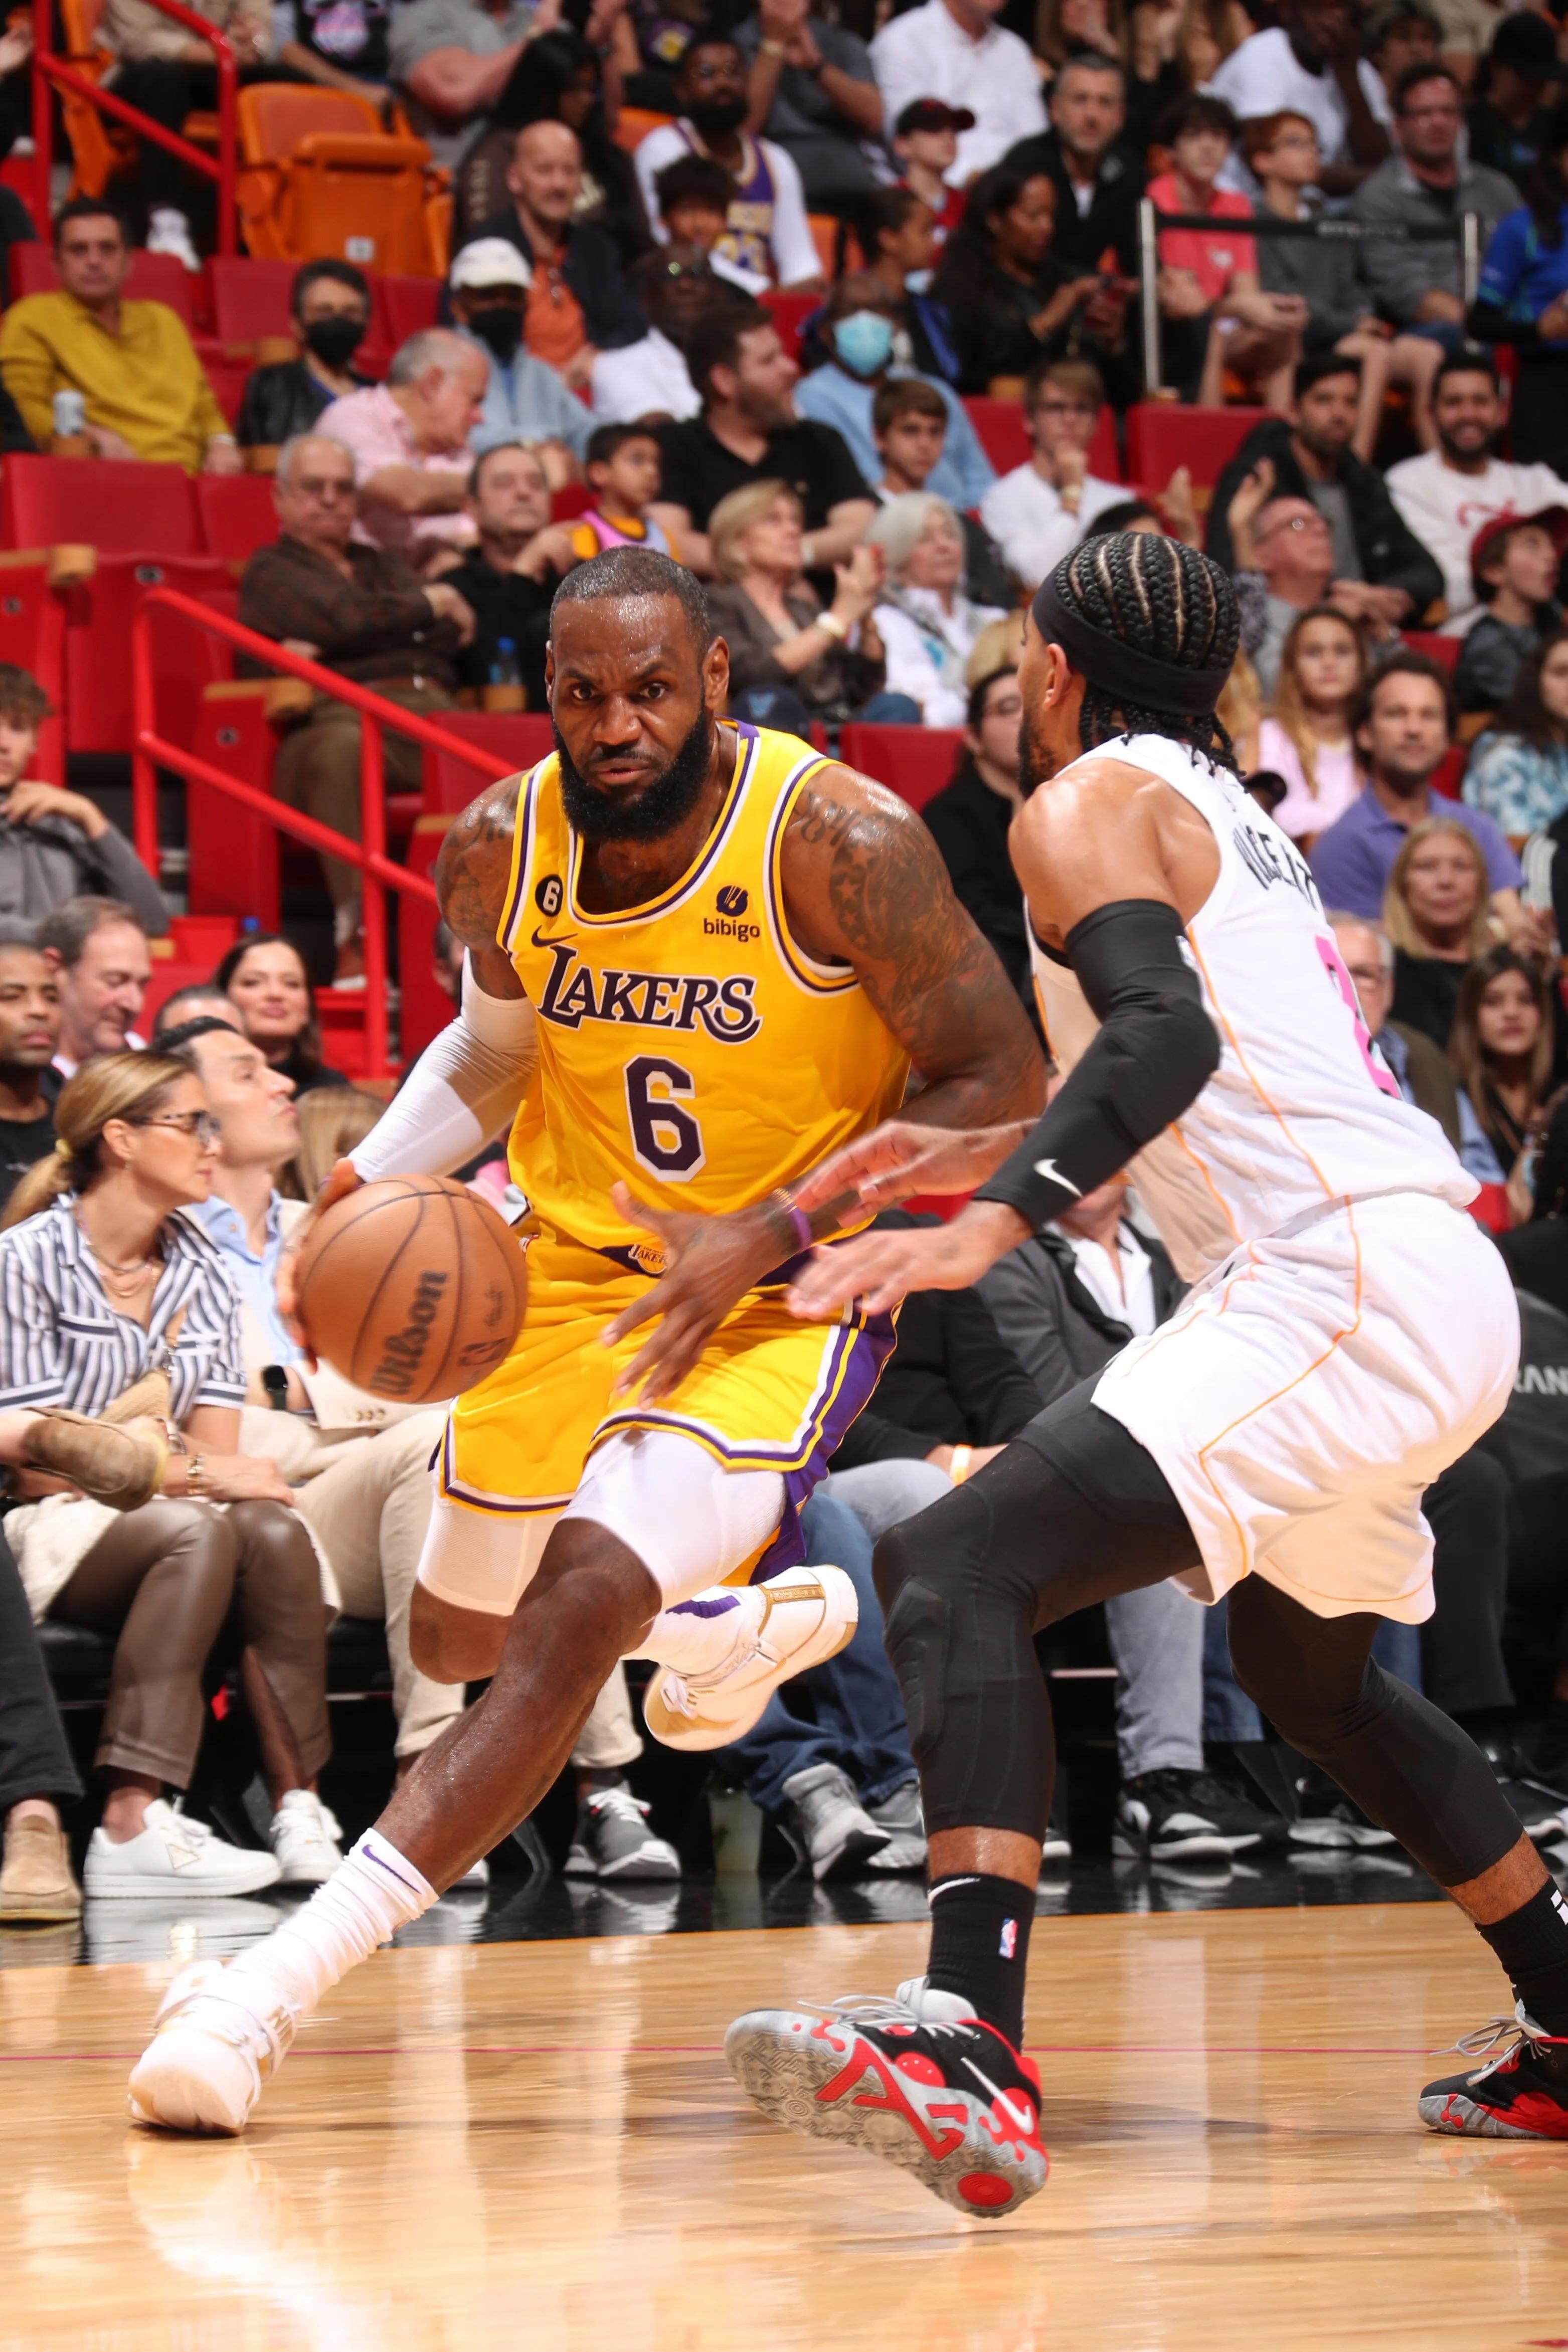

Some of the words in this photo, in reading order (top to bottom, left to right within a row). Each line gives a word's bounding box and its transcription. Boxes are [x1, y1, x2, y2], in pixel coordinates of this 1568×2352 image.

[543, 881, 560, 913] 6
[703, 918, 761, 942] bibigo
[537, 944, 763, 1045] LAKERS
[623, 1053, 707, 1183] 6
[370, 1270, 448, 1395] Wilson
